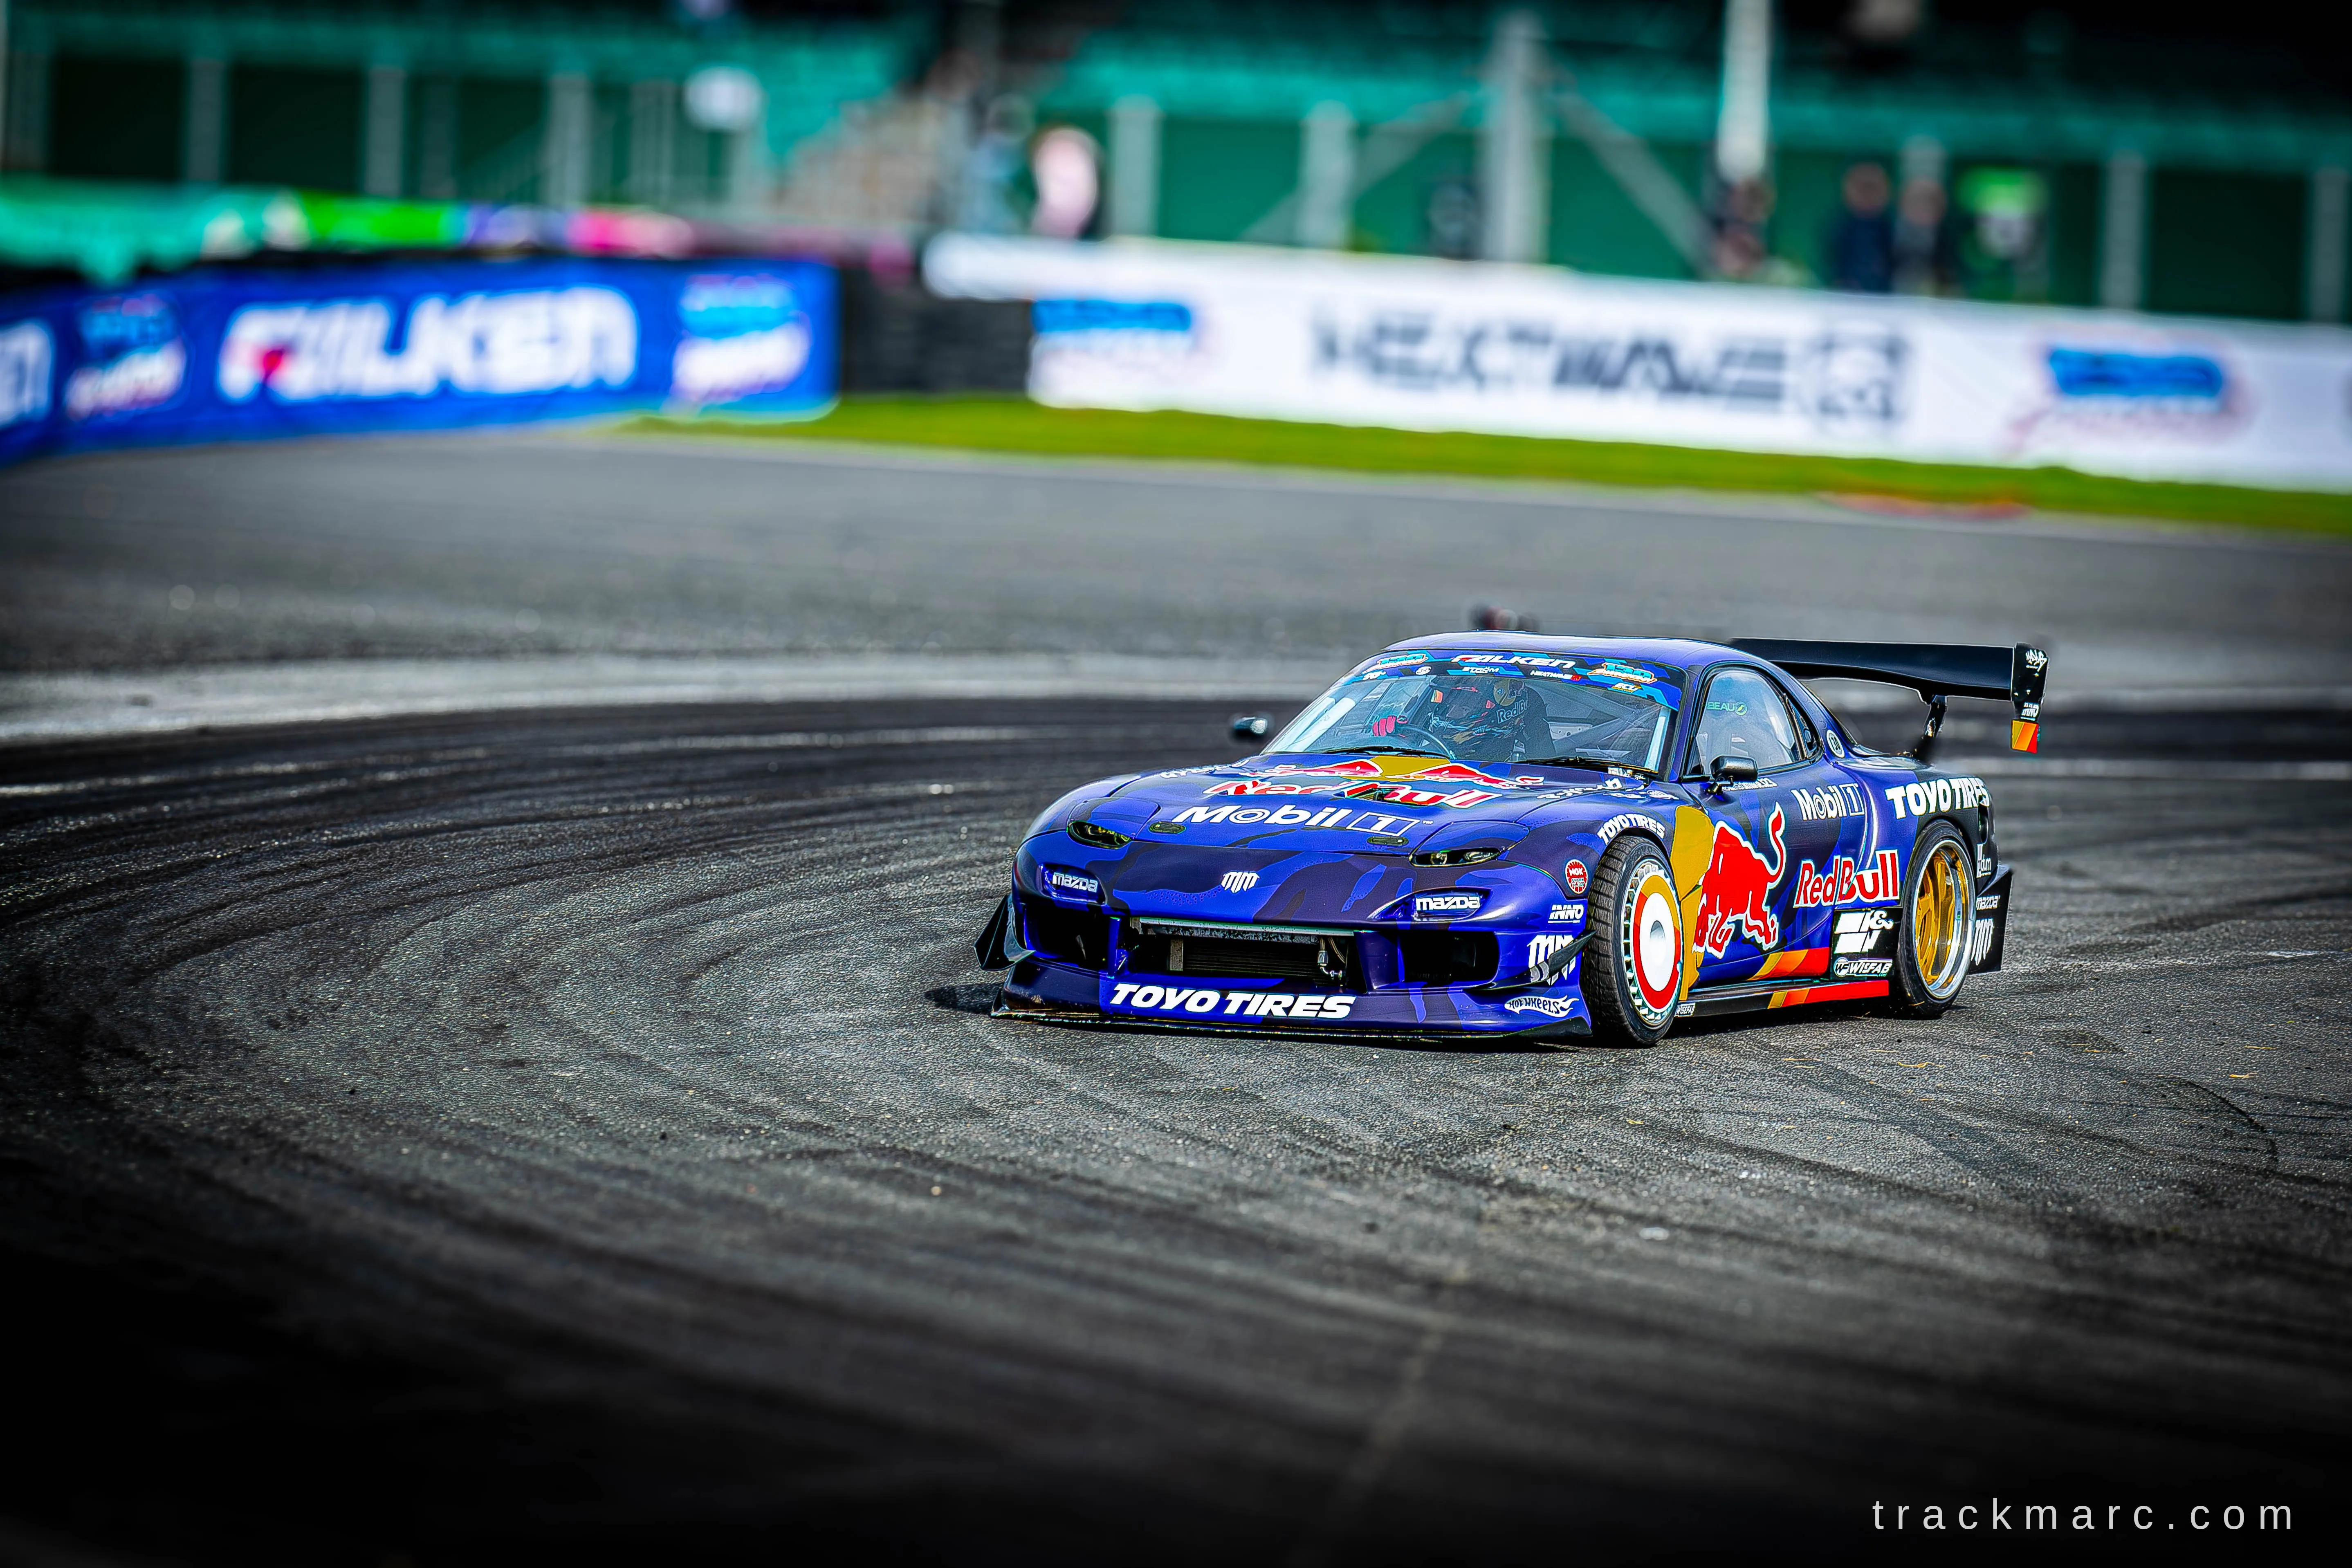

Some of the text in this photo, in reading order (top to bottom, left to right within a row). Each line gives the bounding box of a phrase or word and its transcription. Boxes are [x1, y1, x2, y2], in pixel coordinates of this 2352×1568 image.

[219, 284, 639, 403] FALKEN
[1451, 655, 1575, 668] FALKEN
[1791, 786, 1847, 821] Mobil
[1885, 777, 1990, 819] TOYO TIRES
[1172, 805, 1352, 827] Mobil
[1597, 814, 1665, 845] TOYO TIRES
[1053, 872, 1098, 893] mazda
[1569, 868, 1583, 876] NGK
[1793, 850, 1900, 907] Red Bull
[1416, 896, 1481, 911] mazda
[1549, 904, 1584, 920] INNO
[1110, 983, 1357, 1018] TOYO TIRES
